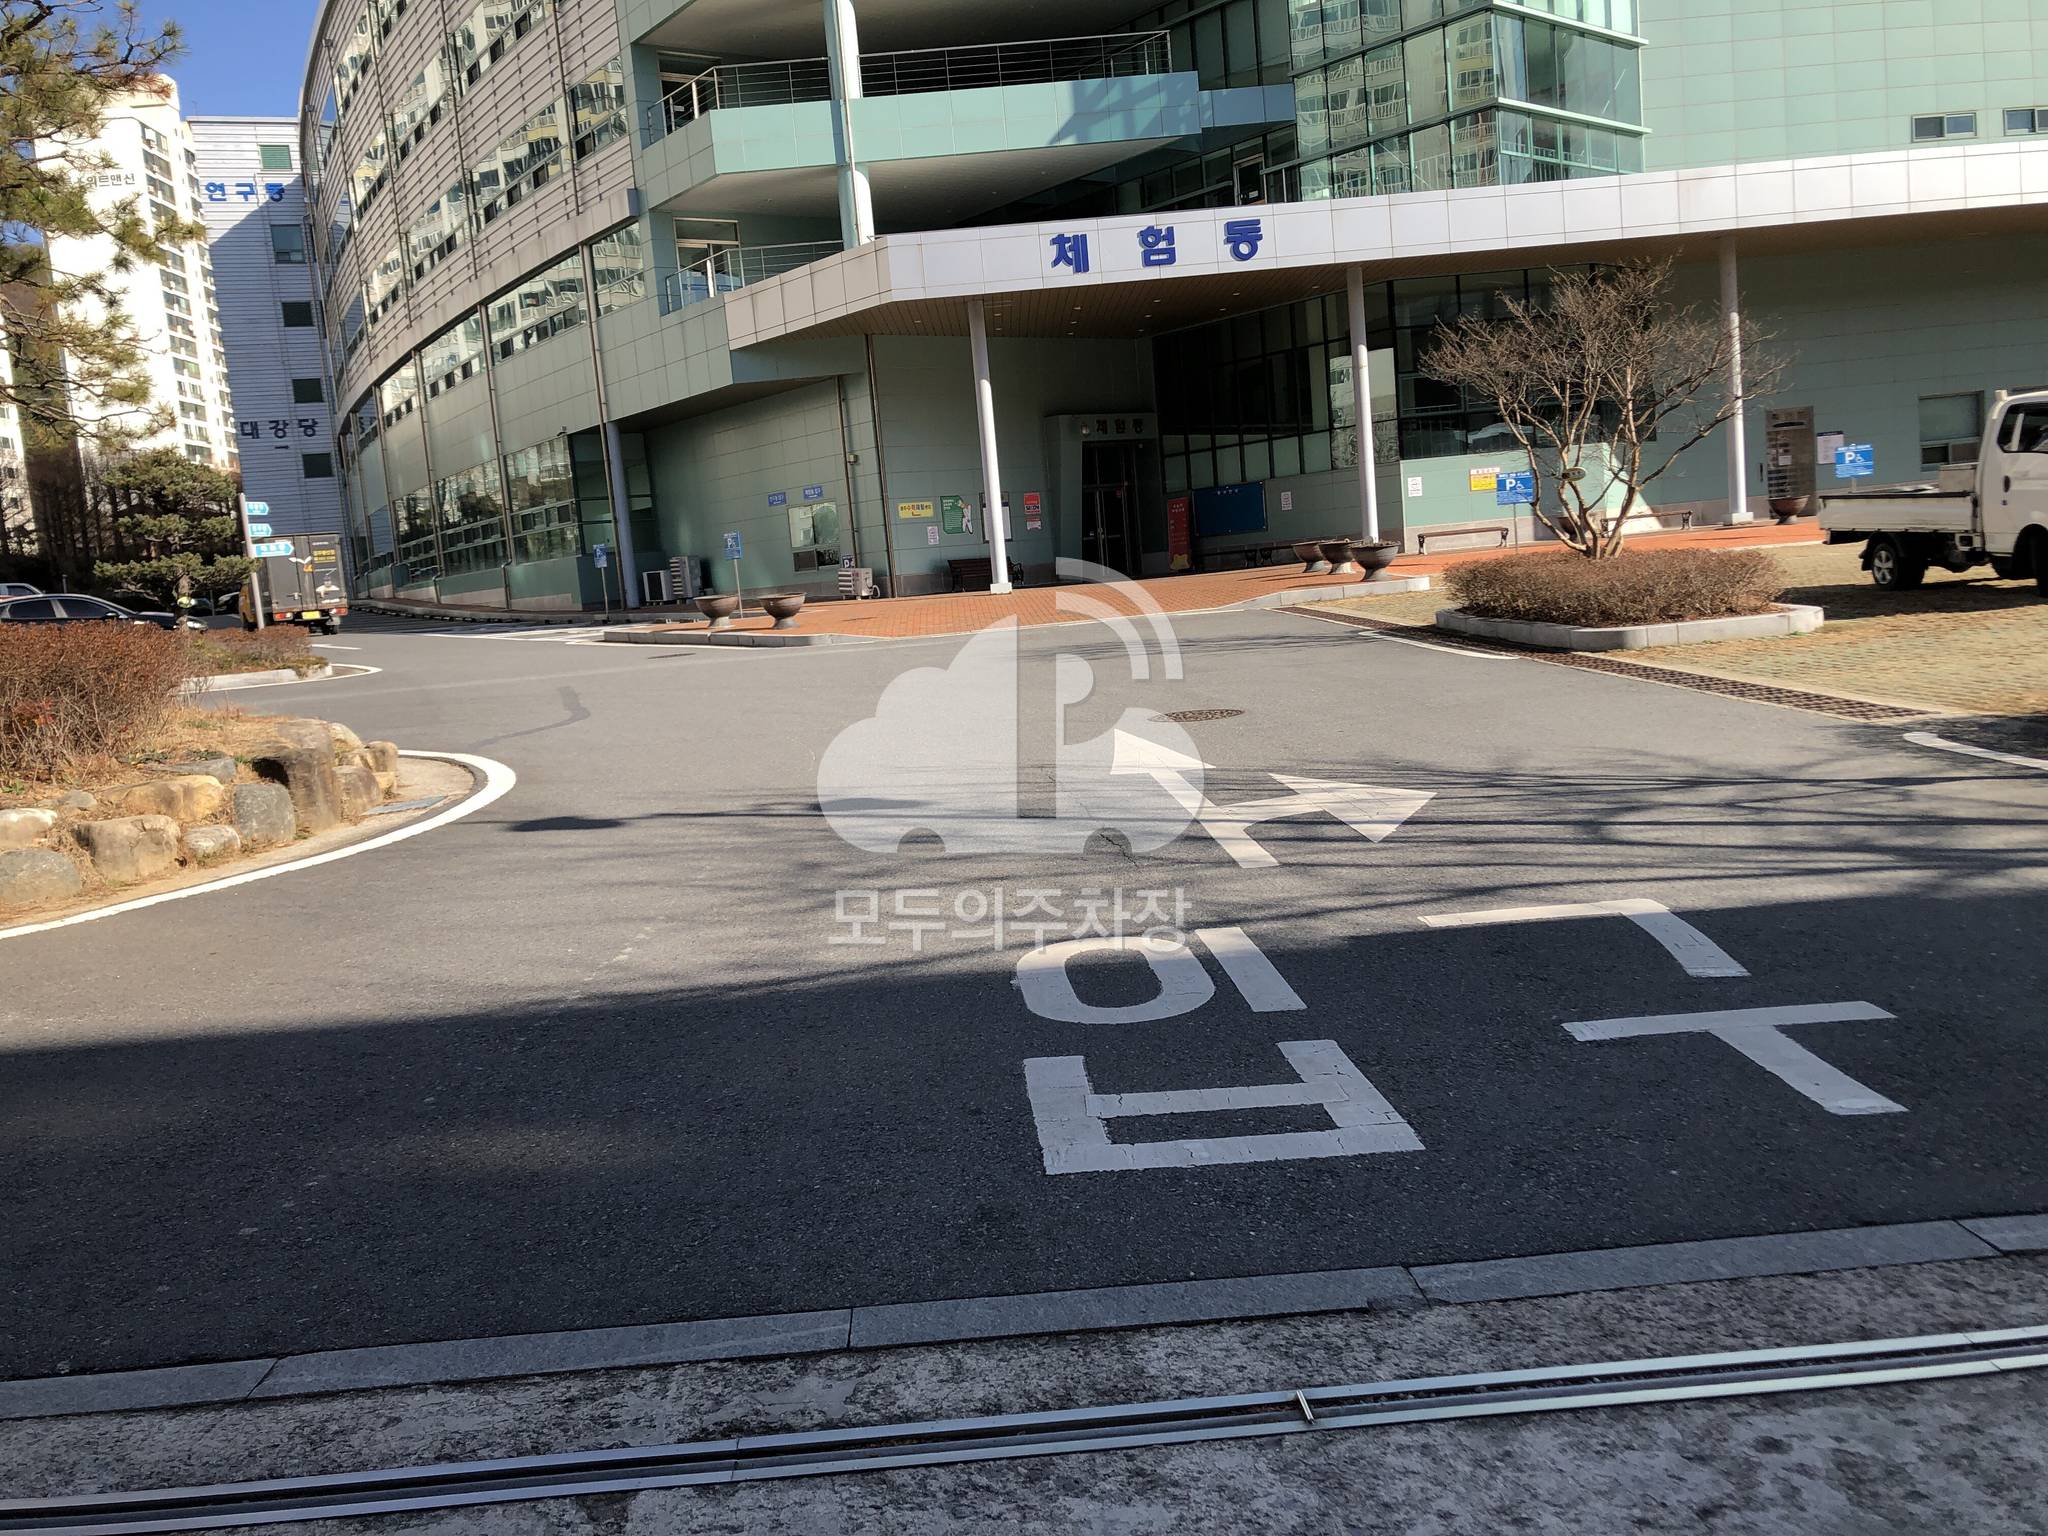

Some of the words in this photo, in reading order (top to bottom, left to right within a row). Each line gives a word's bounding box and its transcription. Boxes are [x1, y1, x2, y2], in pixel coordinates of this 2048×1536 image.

[1049, 218, 1264, 274] 체험동
[1845, 452, 1855, 464] P
[1506, 478, 1516, 491] P
